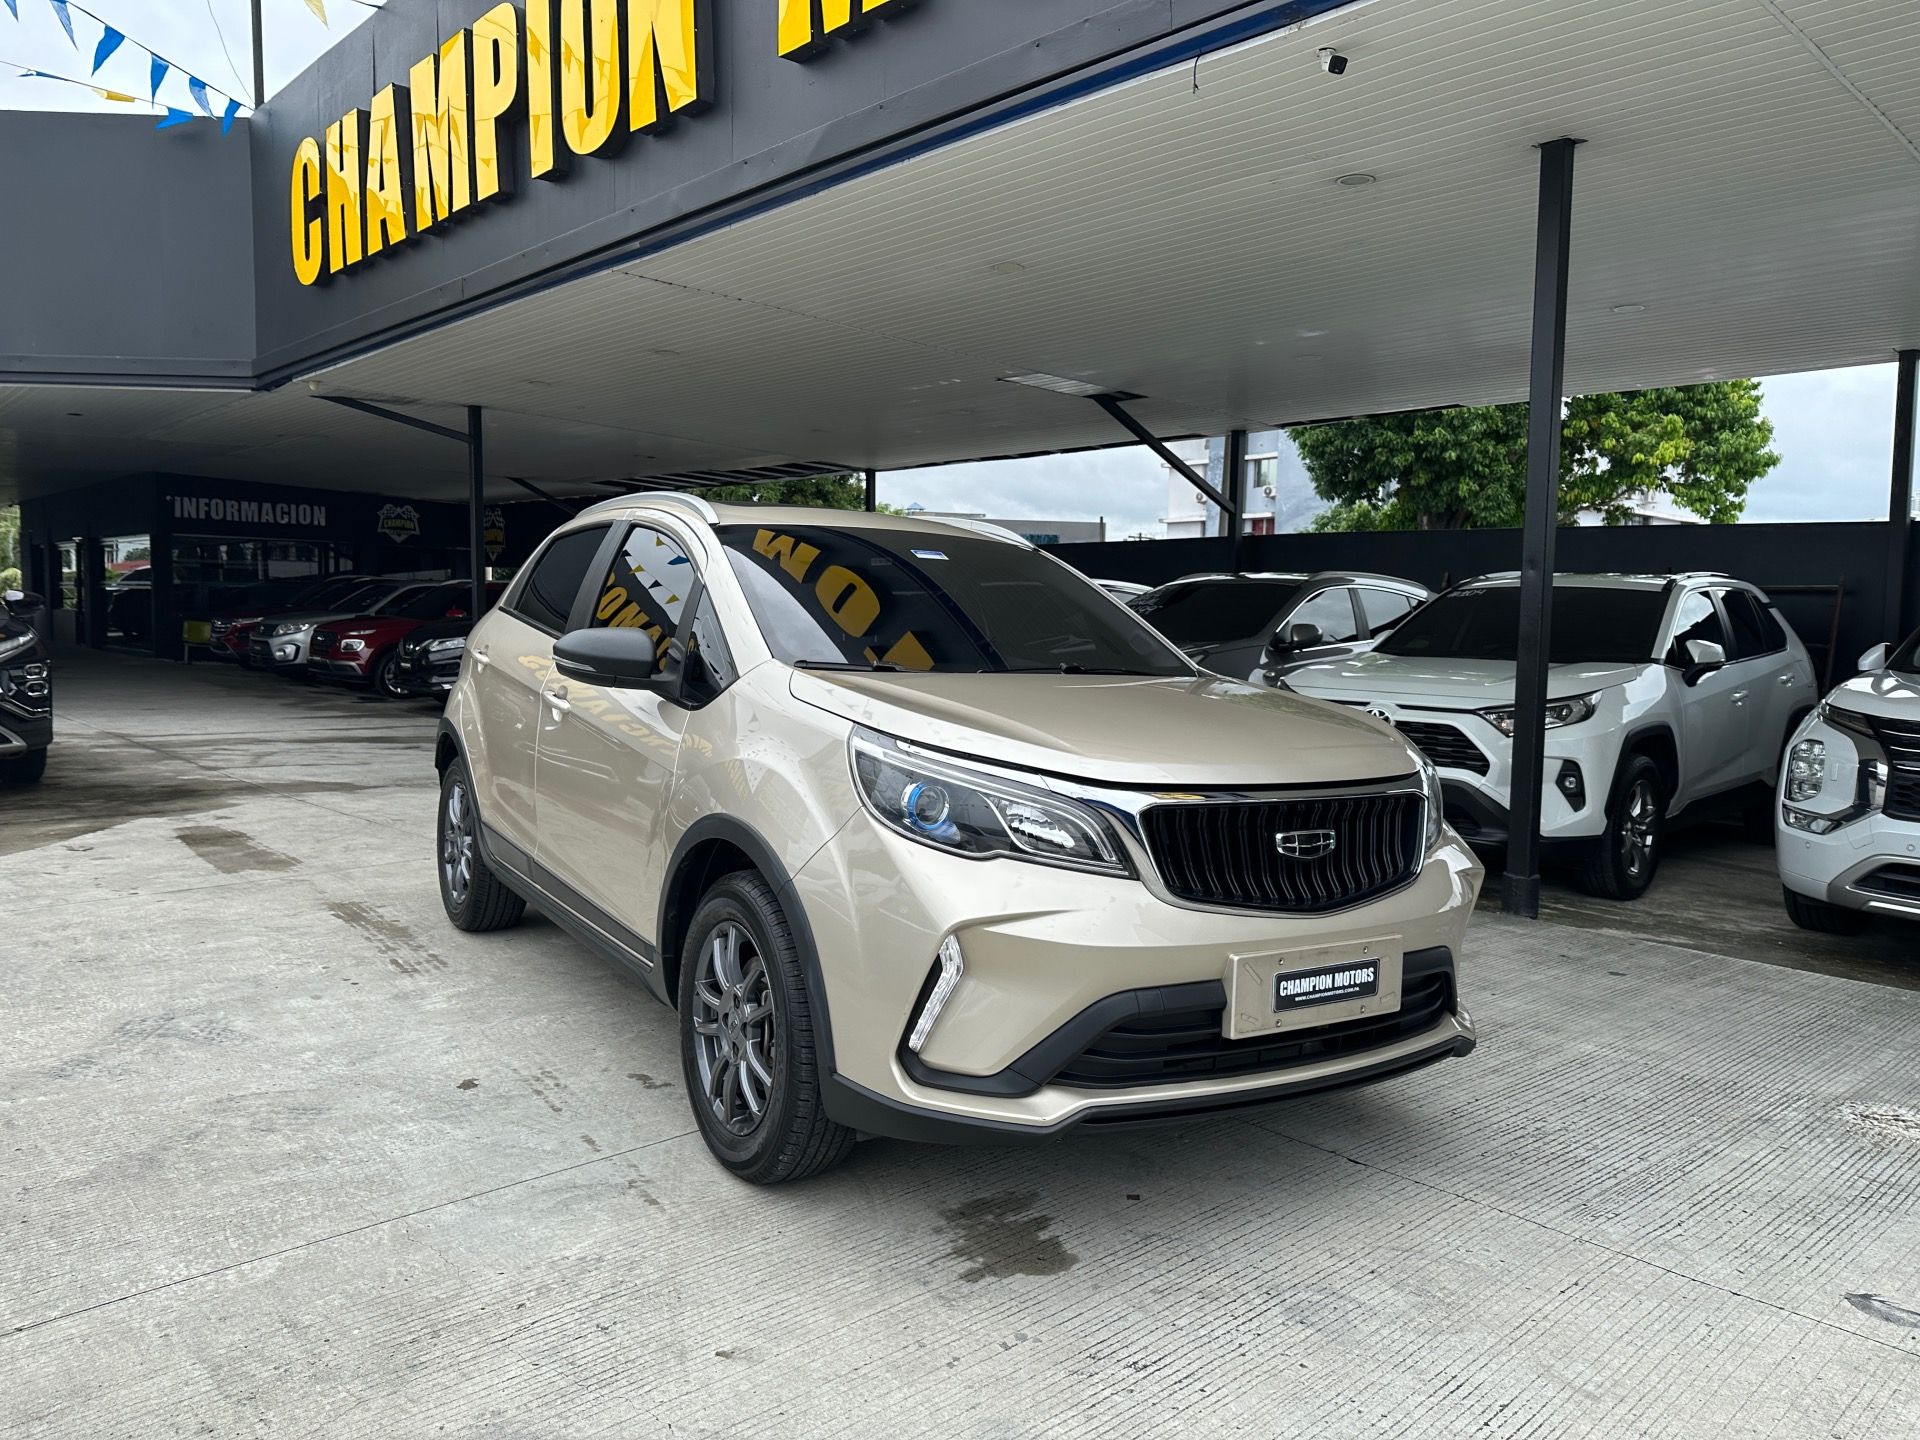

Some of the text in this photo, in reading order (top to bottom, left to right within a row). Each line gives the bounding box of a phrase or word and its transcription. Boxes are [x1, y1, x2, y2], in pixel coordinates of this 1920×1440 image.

[290, 0, 697, 286] CHAMPION
[174, 496, 327, 526] INFORMACION
[1280, 967, 1375, 996] CHAMPION MOTORS
